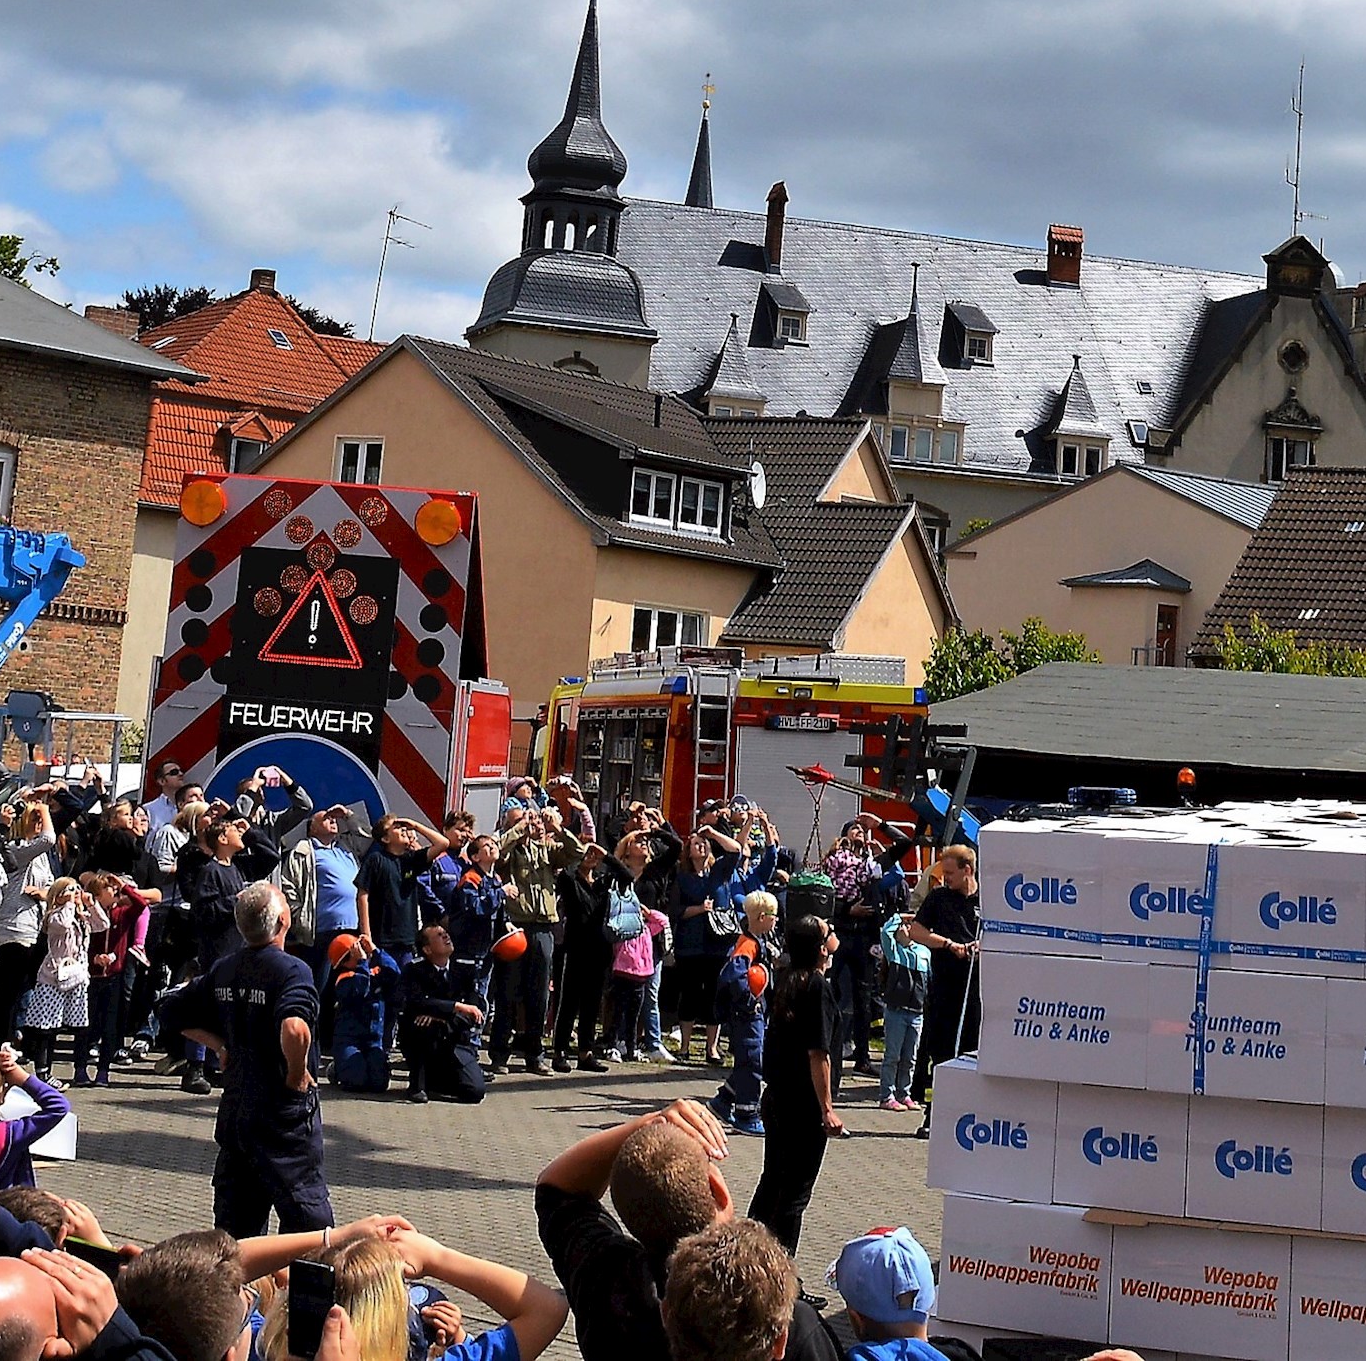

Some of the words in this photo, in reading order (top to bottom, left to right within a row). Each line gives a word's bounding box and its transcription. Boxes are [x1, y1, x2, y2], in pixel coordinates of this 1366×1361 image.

[229, 702, 374, 735] FEUERWEHR
[1004, 873, 1078, 911] Collé
[1129, 882, 1207, 921] Collé
[1259, 892, 1337, 931] Collé
[1017, 996, 1106, 1021] Stuntteam
[1189, 1012, 1281, 1036] untteam
[1013, 1019, 1043, 1038] Tilo
[1048, 1022, 1063, 1040] &
[1066, 1023, 1110, 1044] Anke
[1185, 1034, 1216, 1054] To
[1222, 1036, 1236, 1055] &
[1240, 1038, 1286, 1060] Anke
[955, 1113, 1028, 1152] Collé
[1082, 1127, 1158, 1165] Collé
[1215, 1140, 1292, 1178] Collé
[949, 1254, 1100, 1293] Wellpappenfabrik
[1029, 1245, 1100, 1271] Wepoba
[1121, 1278, 1278, 1312] Wellpappenfabrik
[1204, 1266, 1279, 1291] Wepoba
